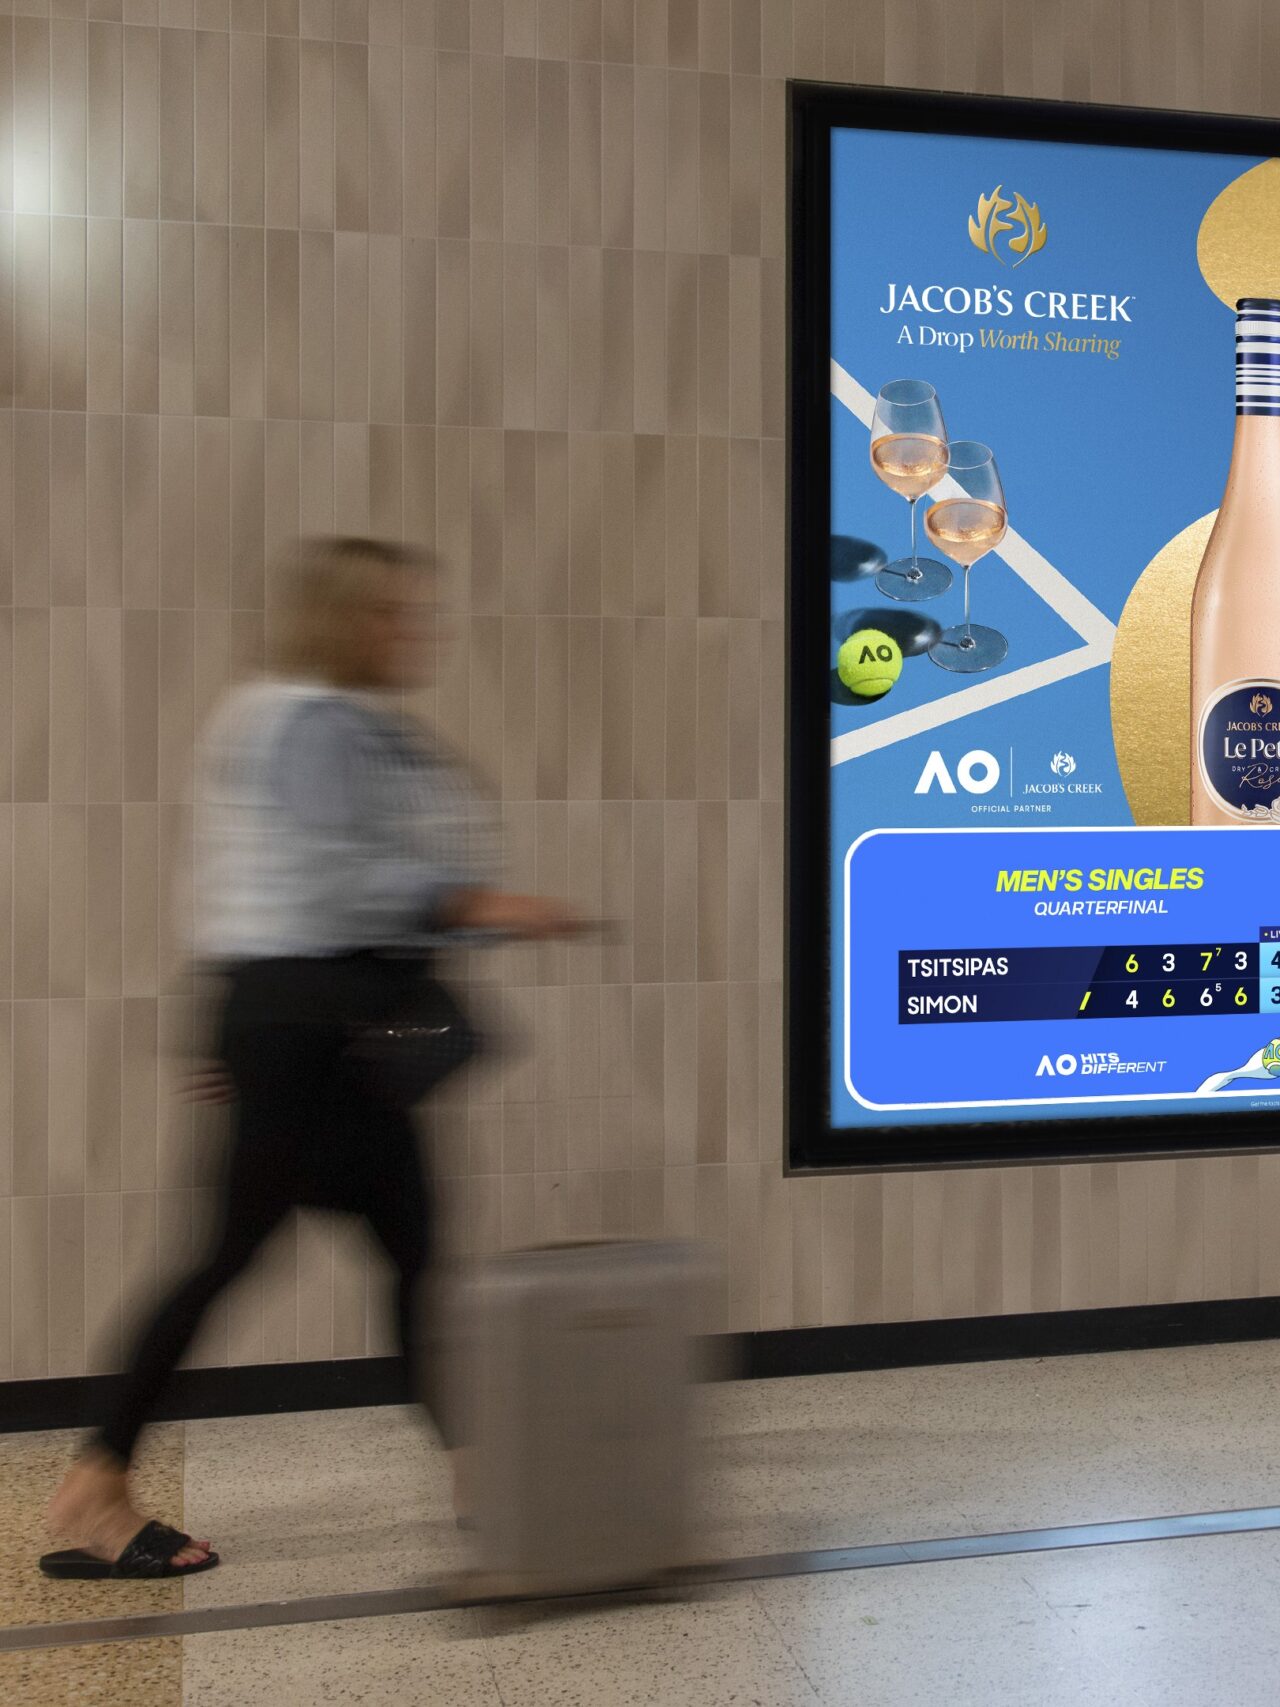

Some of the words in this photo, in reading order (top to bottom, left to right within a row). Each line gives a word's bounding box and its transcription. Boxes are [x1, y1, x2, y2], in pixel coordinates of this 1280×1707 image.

[880, 283, 1013, 316] JACOB'S
[896, 325, 914, 345] A
[919, 325, 974, 353] Drop
[979, 328, 1040, 351] Worth
[1043, 331, 1122, 360] Sharing
[859, 644, 893, 664] AO
[1224, 737, 1247, 759] Le
[914, 750, 1000, 794] AO
[1023, 782, 1065, 794] JACOB'S
[1069, 783, 1102, 793] CREEK
[971, 805, 1010, 813] OFFICIAL
[996, 868, 1083, 892] MEN'S
[1087, 867, 1205, 891] SINGLES
[1034, 899, 1168, 916] QUARTERFINAL
[907, 957, 1009, 978] TSITSIPAS
[1125, 953, 1139, 973] 6
[1162, 953, 1175, 972] 3
[1234, 951, 1248, 970] 3
[907, 994, 978, 1014] SIMON
[1125, 990, 1138, 1008] 4
[1162, 988, 1175, 1008] 6
[1234, 987, 1248, 1006] 6
[1035, 1053, 1077, 1076] AO
[1080, 1052, 1120, 1064] HITS
[1080, 1061, 1167, 1075] DIFFERENT
